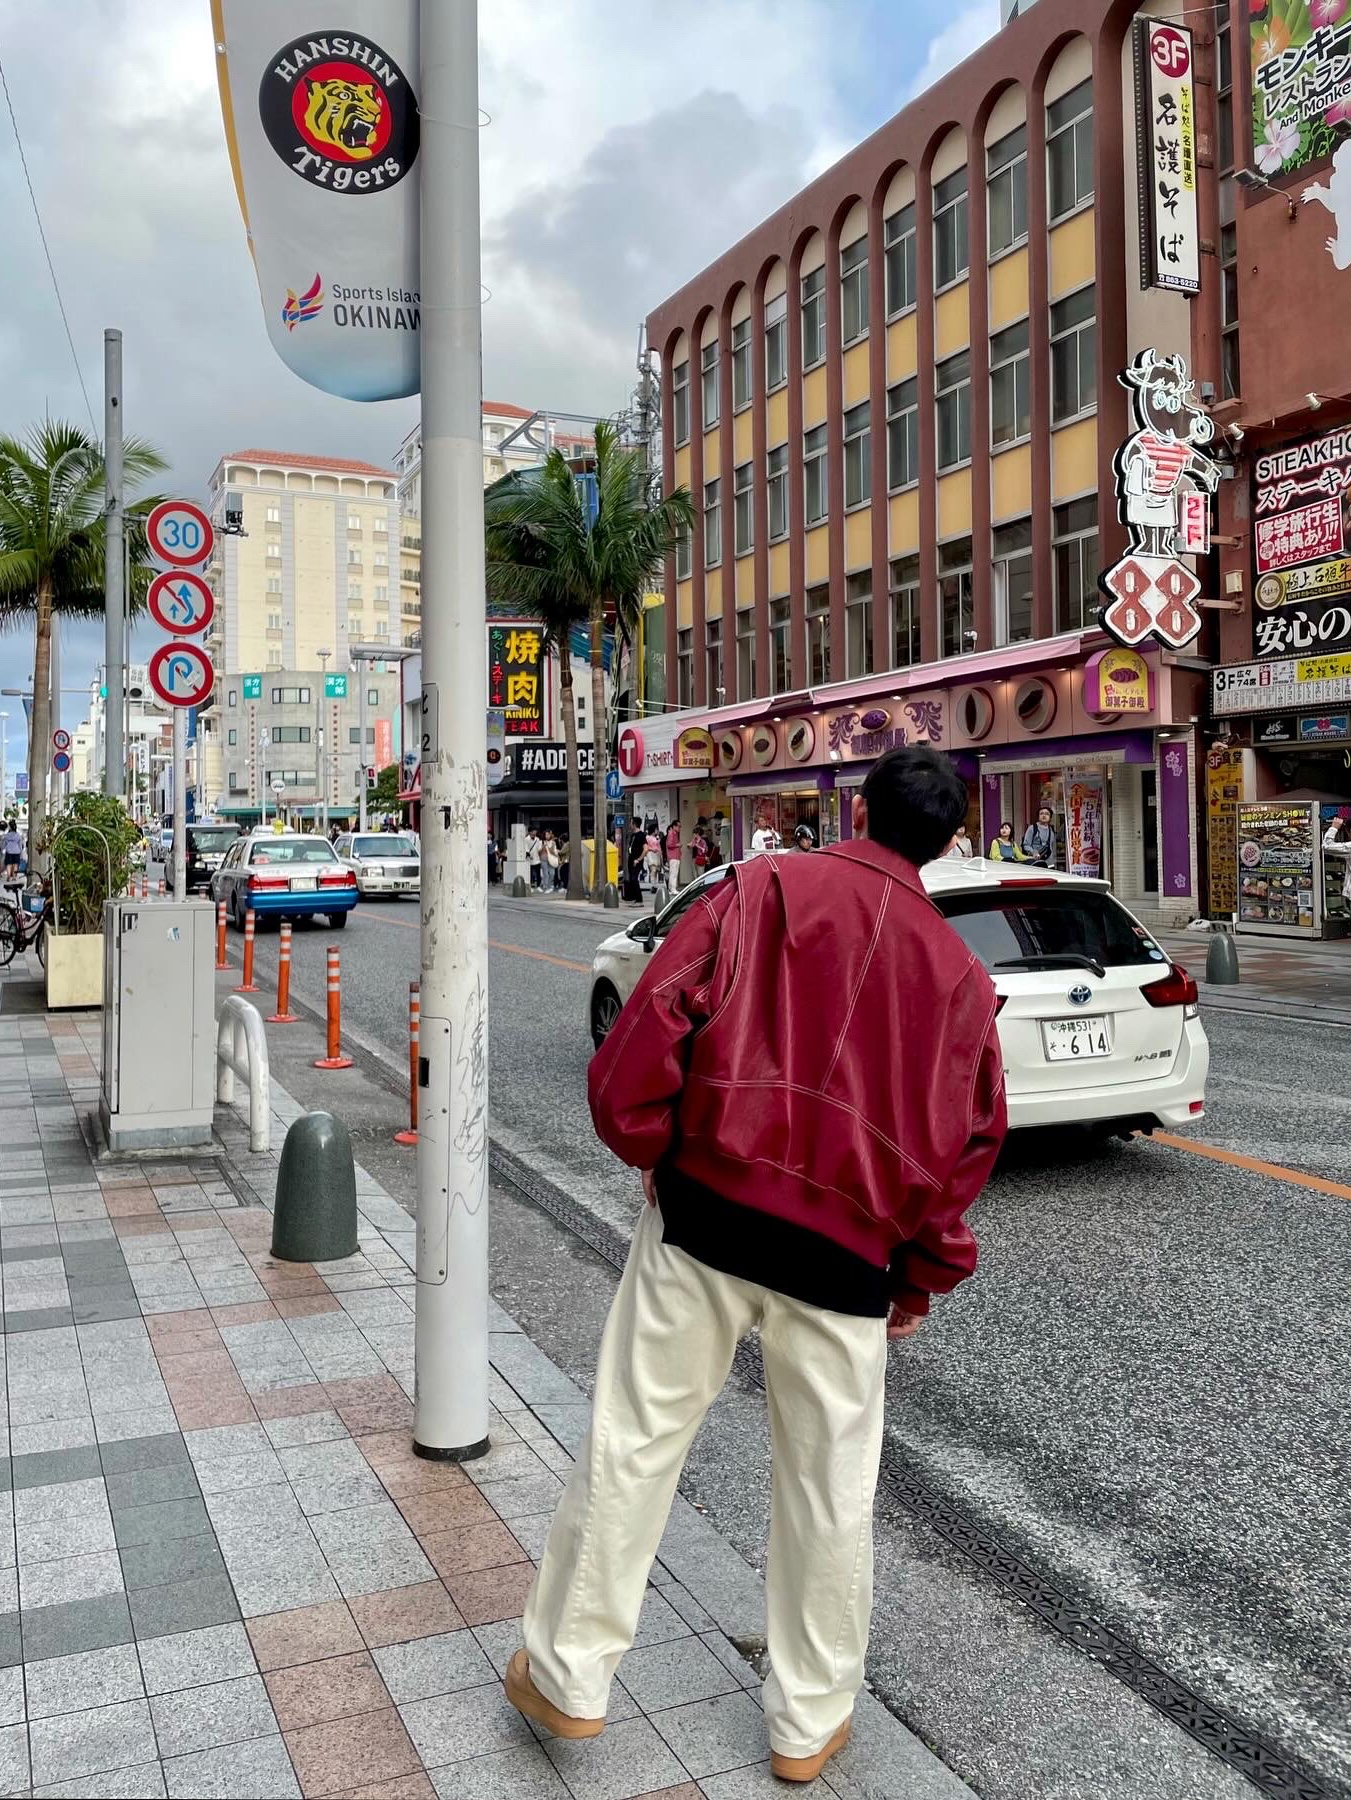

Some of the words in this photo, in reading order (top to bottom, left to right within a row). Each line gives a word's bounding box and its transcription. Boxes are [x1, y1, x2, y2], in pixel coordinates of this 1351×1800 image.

[274, 38, 398, 87] HANSHIN
[1152, 35, 1186, 68] 3F
[1257, 24, 1351, 90] モンキー
[1265, 57, 1350, 117] レストラン
[1280, 111, 1298, 130] And
[1304, 82, 1351, 117] Monke
[292, 146, 400, 189] Tigers
[1155, 93, 1184, 263] 名護そば
[332, 284, 383, 301] Sports
[163, 520, 199, 548] 30
[1258, 501, 1339, 542] 修学旅行生
[1256, 607, 1351, 656] 安心の
[505, 630, 540, 705] 焼肉
[1215, 670, 1236, 692] 3F
[621, 739, 635, 770] T
[1209, 756, 1221, 768] 3F
